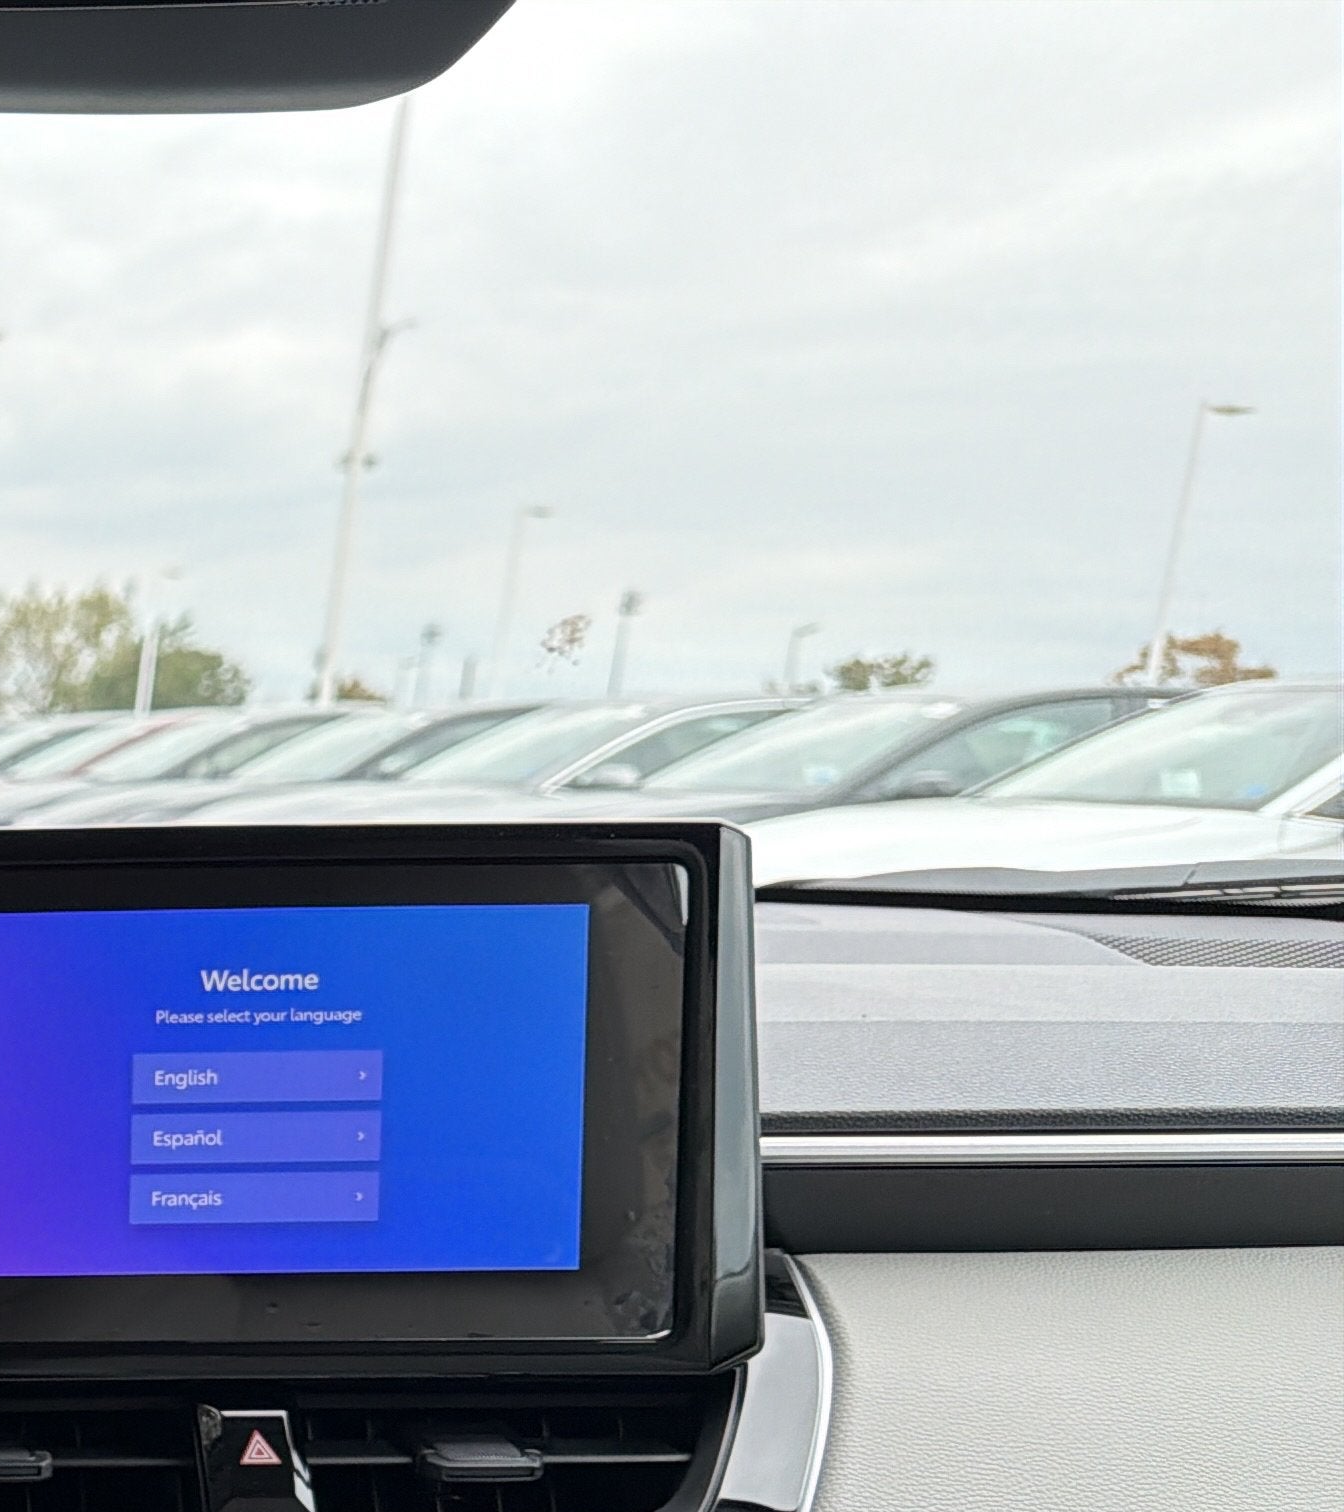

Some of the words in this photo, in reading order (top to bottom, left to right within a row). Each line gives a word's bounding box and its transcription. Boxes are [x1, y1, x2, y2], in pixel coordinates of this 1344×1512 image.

[201, 969, 319, 992] Welcome
[156, 1010, 203, 1024] Please
[207, 1009, 250, 1023] select
[253, 1011, 288, 1026] your
[291, 1008, 362, 1026] language
[154, 1069, 218, 1090] English
[153, 1129, 223, 1149] Español
[151, 1190, 222, 1210] Français
